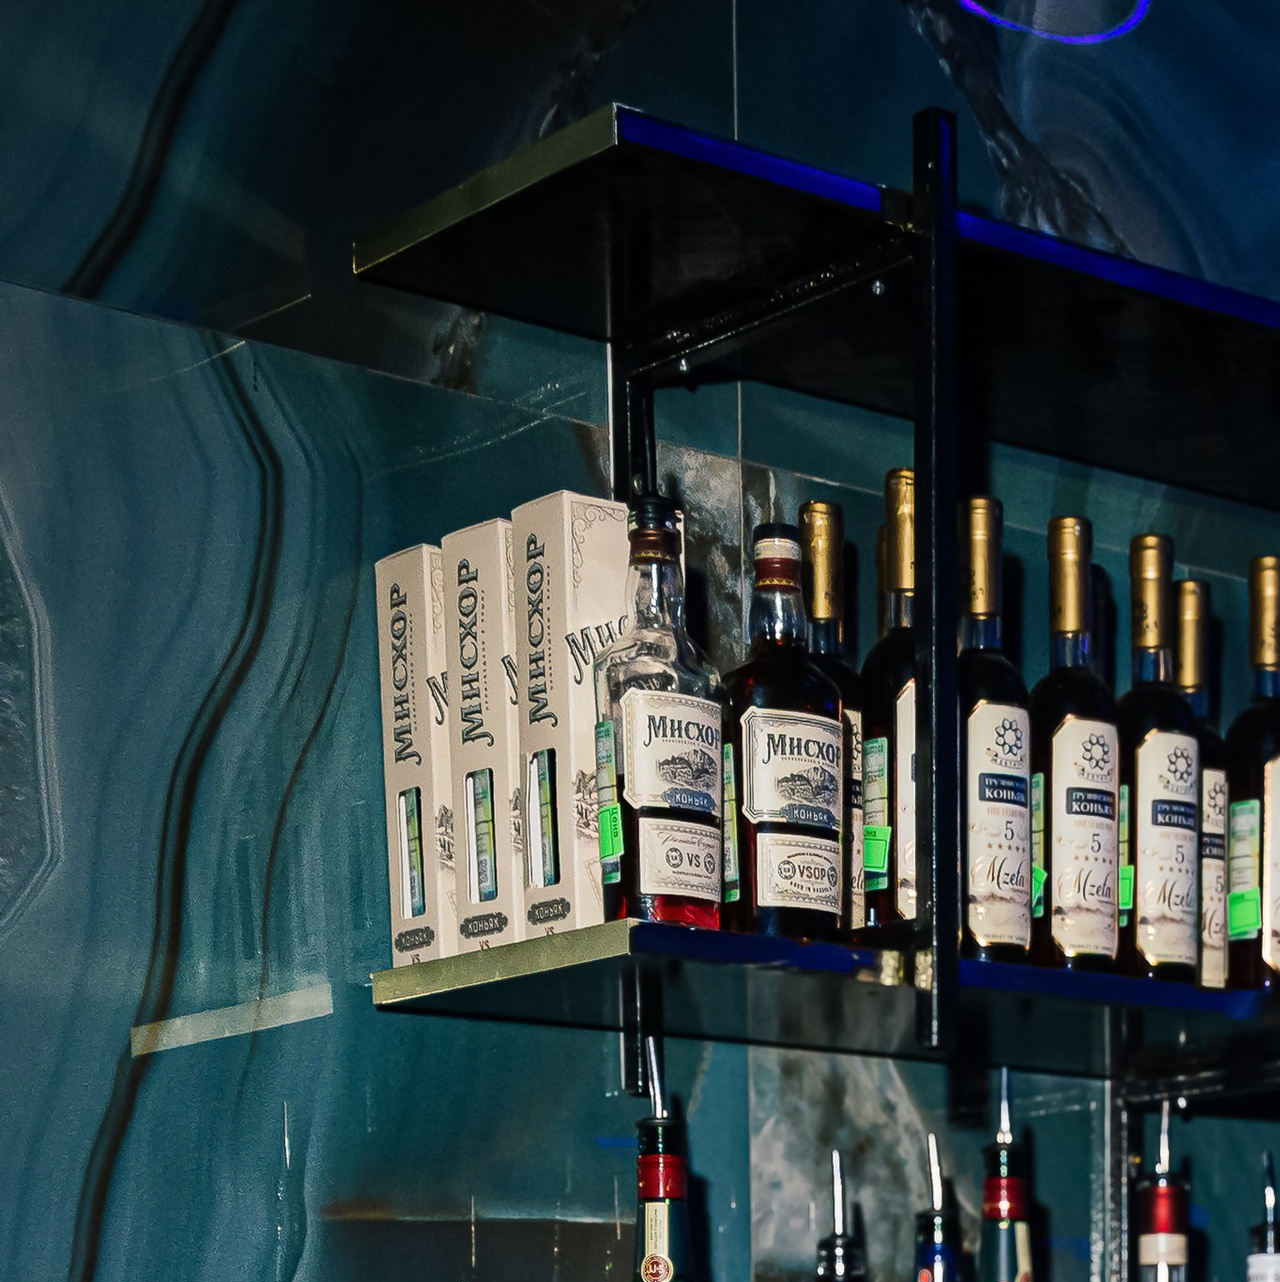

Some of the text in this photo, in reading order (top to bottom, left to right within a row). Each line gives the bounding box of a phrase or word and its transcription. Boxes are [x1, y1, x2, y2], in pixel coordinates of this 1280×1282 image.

[1004, 821, 1015, 841] 5
[1091, 833, 1101, 853] 5
[686, 852, 701, 868] VS
[1175, 845, 1185, 864] 5
[797, 865, 826, 881] VSOP
